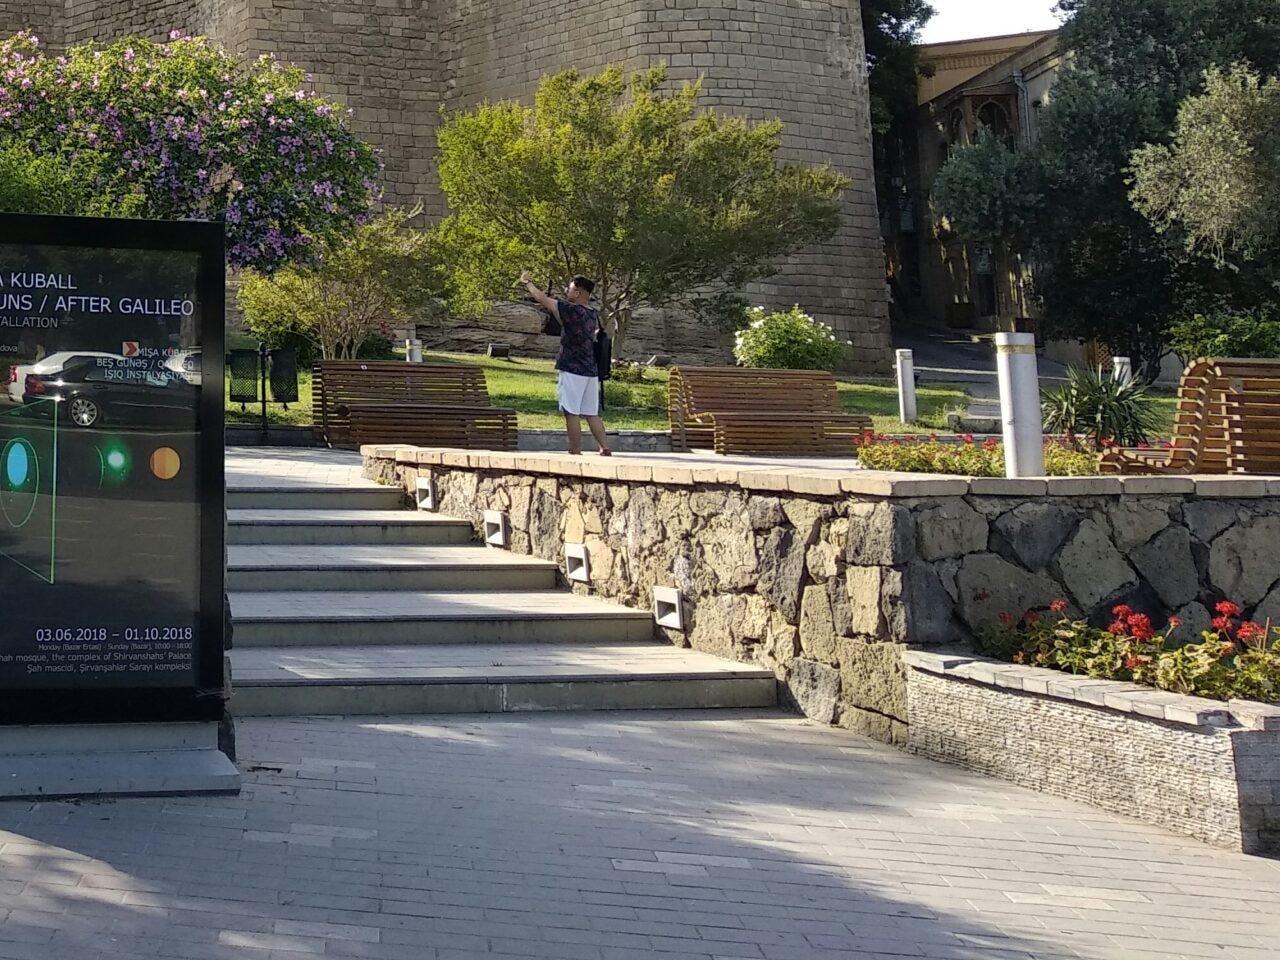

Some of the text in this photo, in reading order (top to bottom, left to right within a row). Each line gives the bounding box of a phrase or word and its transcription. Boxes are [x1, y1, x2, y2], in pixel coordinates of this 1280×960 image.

[10, 272, 78, 290] KUBALL
[38, 294, 48, 314] /
[54, 295, 112, 313] AFTER
[118, 297, 194, 316] GALILEO
[96, 358, 114, 369] BEŞ
[36, 628, 107, 641] 03.06.2018
[124, 627, 193, 640] 01.10.2018
[15, 653, 49, 663] mosque,
[51, 653, 66, 662] the
[67, 652, 101, 663] complex
[103, 652, 113, 661] of
[168, 651, 192, 660] Palace
[26, 664, 42, 675] Şah
[79, 662, 127, 674] Şirvanşahlar
